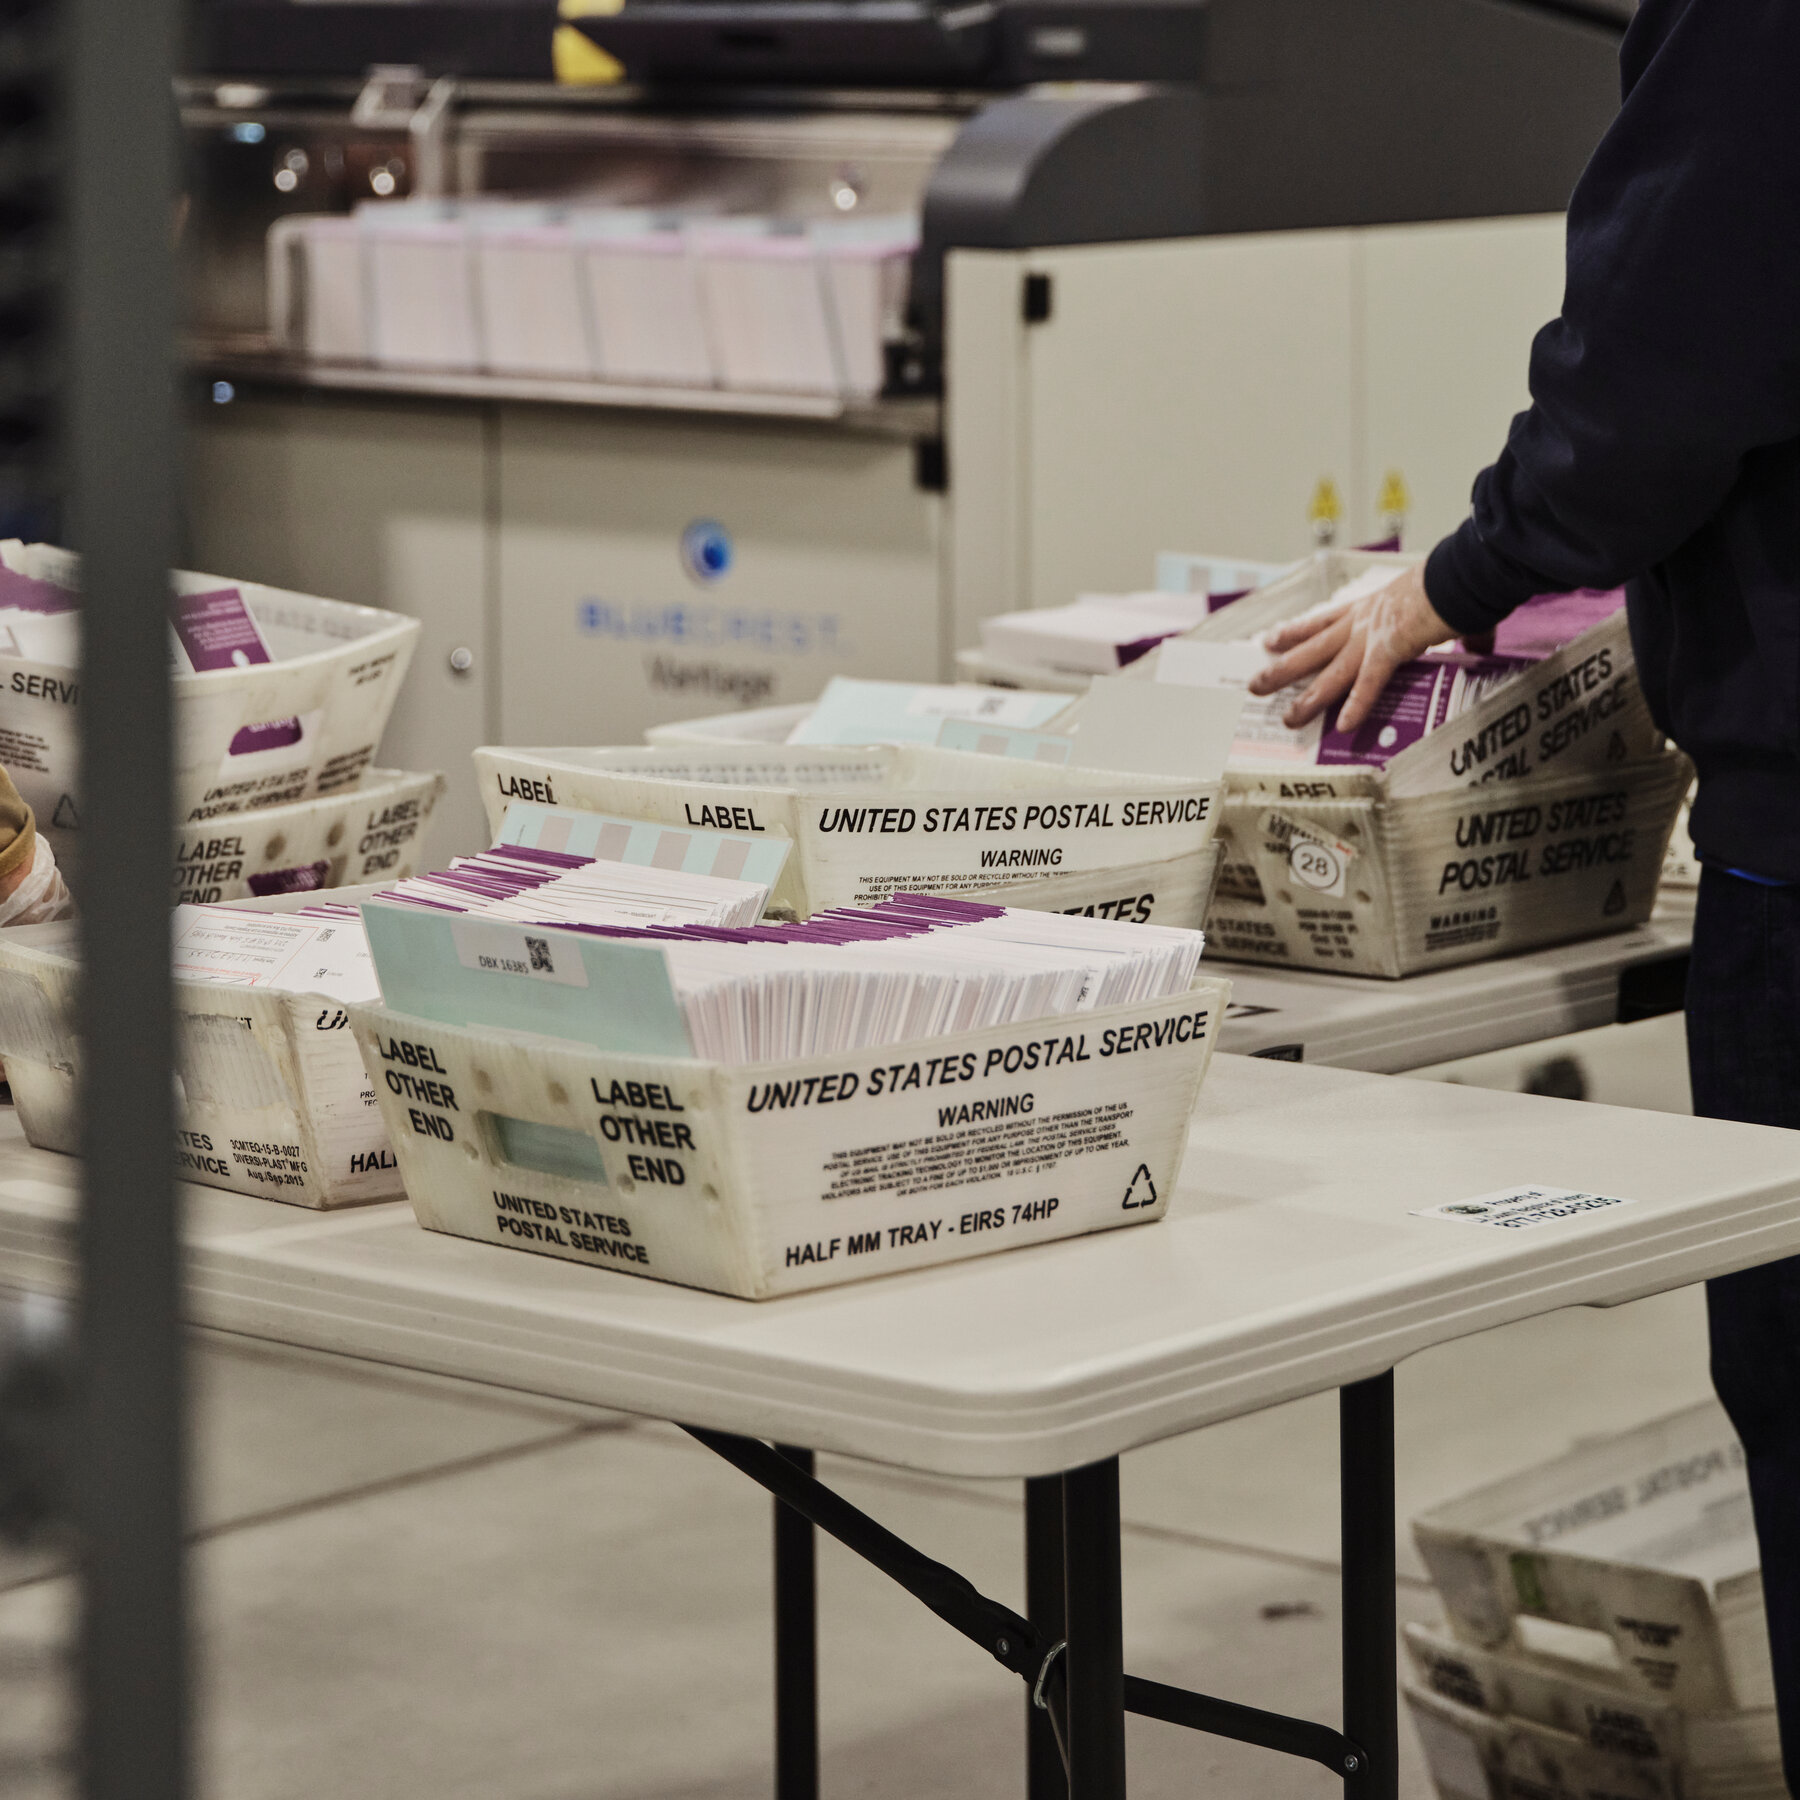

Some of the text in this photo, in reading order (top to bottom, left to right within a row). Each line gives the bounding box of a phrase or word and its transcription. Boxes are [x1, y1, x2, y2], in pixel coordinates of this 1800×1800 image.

[11, 671, 79, 706] SERVI
[1450, 648, 1612, 776] UNITED STATES
[1468, 674, 1628, 788] STAL SERVICE
[497, 773, 558, 805] LABEL
[367, 799, 421, 831] LABEL
[684, 803, 765, 832] LABEL
[818, 797, 1211, 833] UNITED STATES POSTAL SERVICE
[1456, 791, 1629, 849] UNITED STATES
[176, 836, 246, 863] LABEL
[358, 821, 419, 855] OTHER
[362, 848, 400, 876] END
[980, 848, 1063, 868] WARNING
[1300, 852, 1328, 877] 28
[1438, 851, 1531, 895] POSTAL
[1539, 828, 1637, 878] SERVICE
[874, 875, 911, 884] EQUIPMENT
[941, 874, 950, 882] BE
[968, 873, 978, 881] OR
[978, 872, 1010, 880] RECYCLED
[1039, 871, 1050, 879] THE
[883, 884, 892, 892] OF
[908, 883, 944, 891] EQUIPMENT
[959, 882, 972, 890] ANY
[854, 893, 890, 901] PROHIBITE
[1049, 893, 1155, 924] ATES
[1429, 906, 1498, 930] WARNING
[375, 1032, 447, 1075] LABEL
[746, 1010, 1209, 1114] UNITED STATES POSTAL SERVICE
[385, 1069, 460, 1112] OTHER
[590, 1077, 685, 1112] LABEL
[407, 1107, 455, 1143] END
[938, 1092, 1036, 1128] WARNING
[1052, 1108, 1092, 1122] PERMISSION
[1094, 1106, 1103, 1114] OF
[1105, 1104, 1117, 1112] THE
[180, 1130, 214, 1151] TES
[597, 1114, 698, 1151] OTHER
[1022, 1142, 1056, 1155] LOCATION
[178, 1152, 231, 1177] RVICE
[350, 1150, 398, 1174] HAL
[627, 1153, 686, 1186] END
[493, 1190, 631, 1237] UNITED STATES
[496, 1214, 650, 1265] POSTAL SERVICE
[785, 1238, 842, 1268] HALF
[847, 1230, 882, 1257] MM
[887, 1218, 943, 1249] TRAY
[959, 1208, 1006, 1236] EIRS
[1011, 1197, 1060, 1226] 74HP
